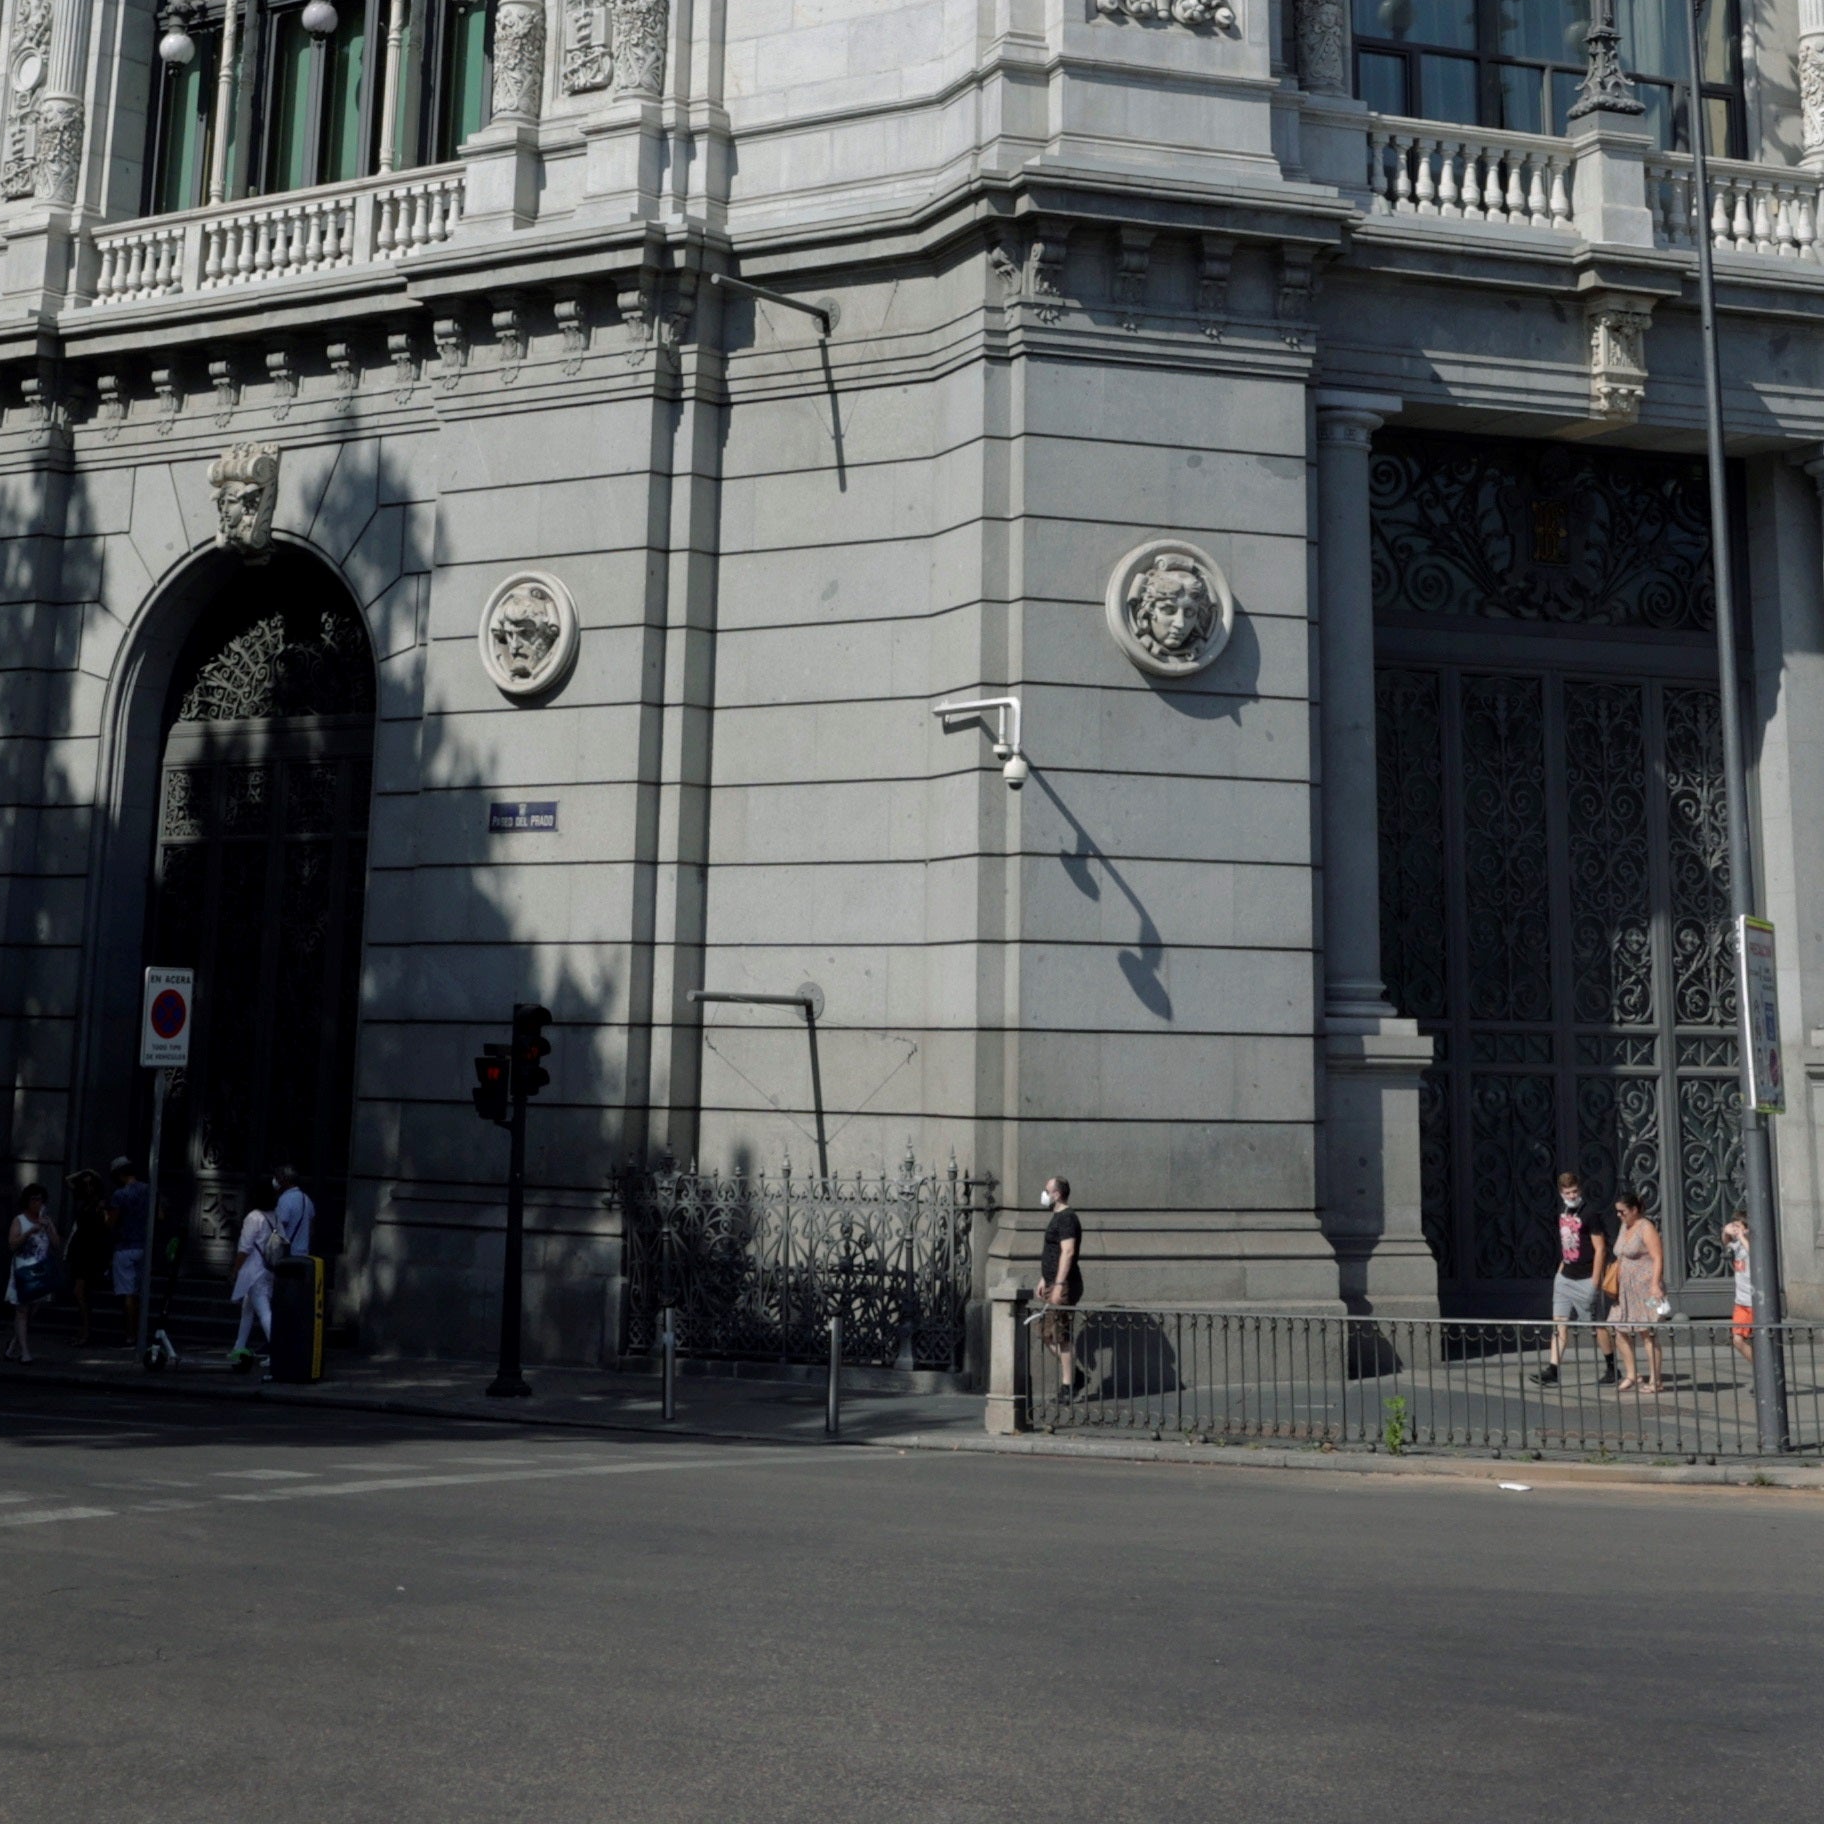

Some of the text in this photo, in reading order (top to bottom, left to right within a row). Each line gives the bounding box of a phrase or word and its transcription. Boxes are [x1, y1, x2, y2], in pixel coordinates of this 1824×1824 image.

[515, 817, 528, 827] DEL
[530, 814, 554, 827] PRADO
[150, 975, 191, 985] EN ACERA
